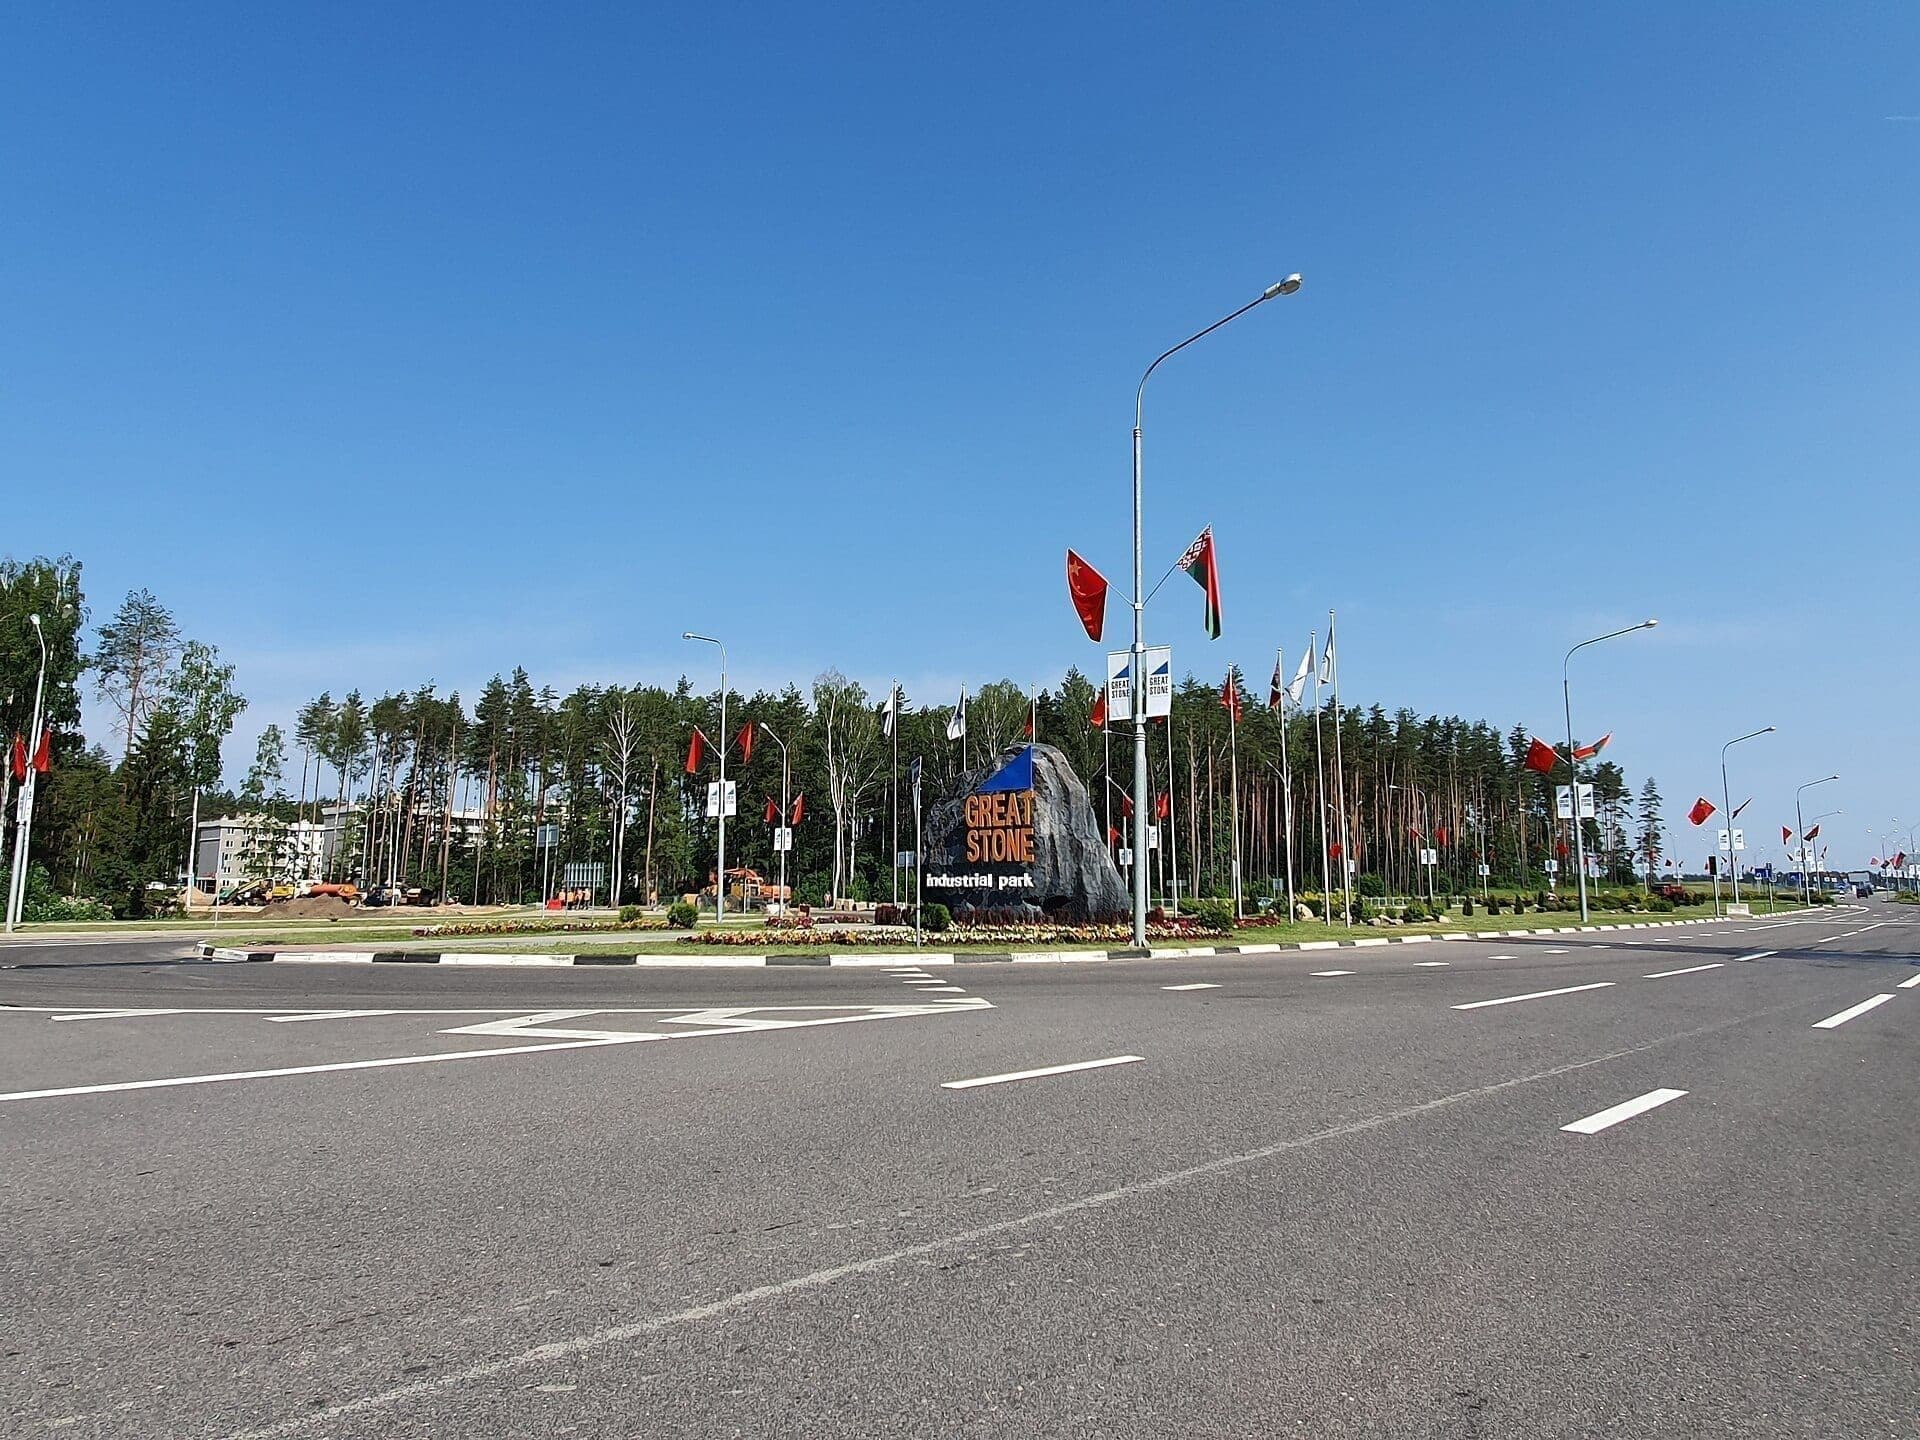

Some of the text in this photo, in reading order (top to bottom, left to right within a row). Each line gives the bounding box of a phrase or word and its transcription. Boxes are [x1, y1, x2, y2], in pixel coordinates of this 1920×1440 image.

[1111, 680, 1130, 690] GREAT
[1149, 676, 1169, 686] GREAT
[1111, 689, 1130, 699] STONE
[1149, 686, 1169, 695] STONE
[964, 791, 1035, 828] GREAT
[966, 828, 1035, 863] STONE
[926, 872, 1034, 890] industrial park
